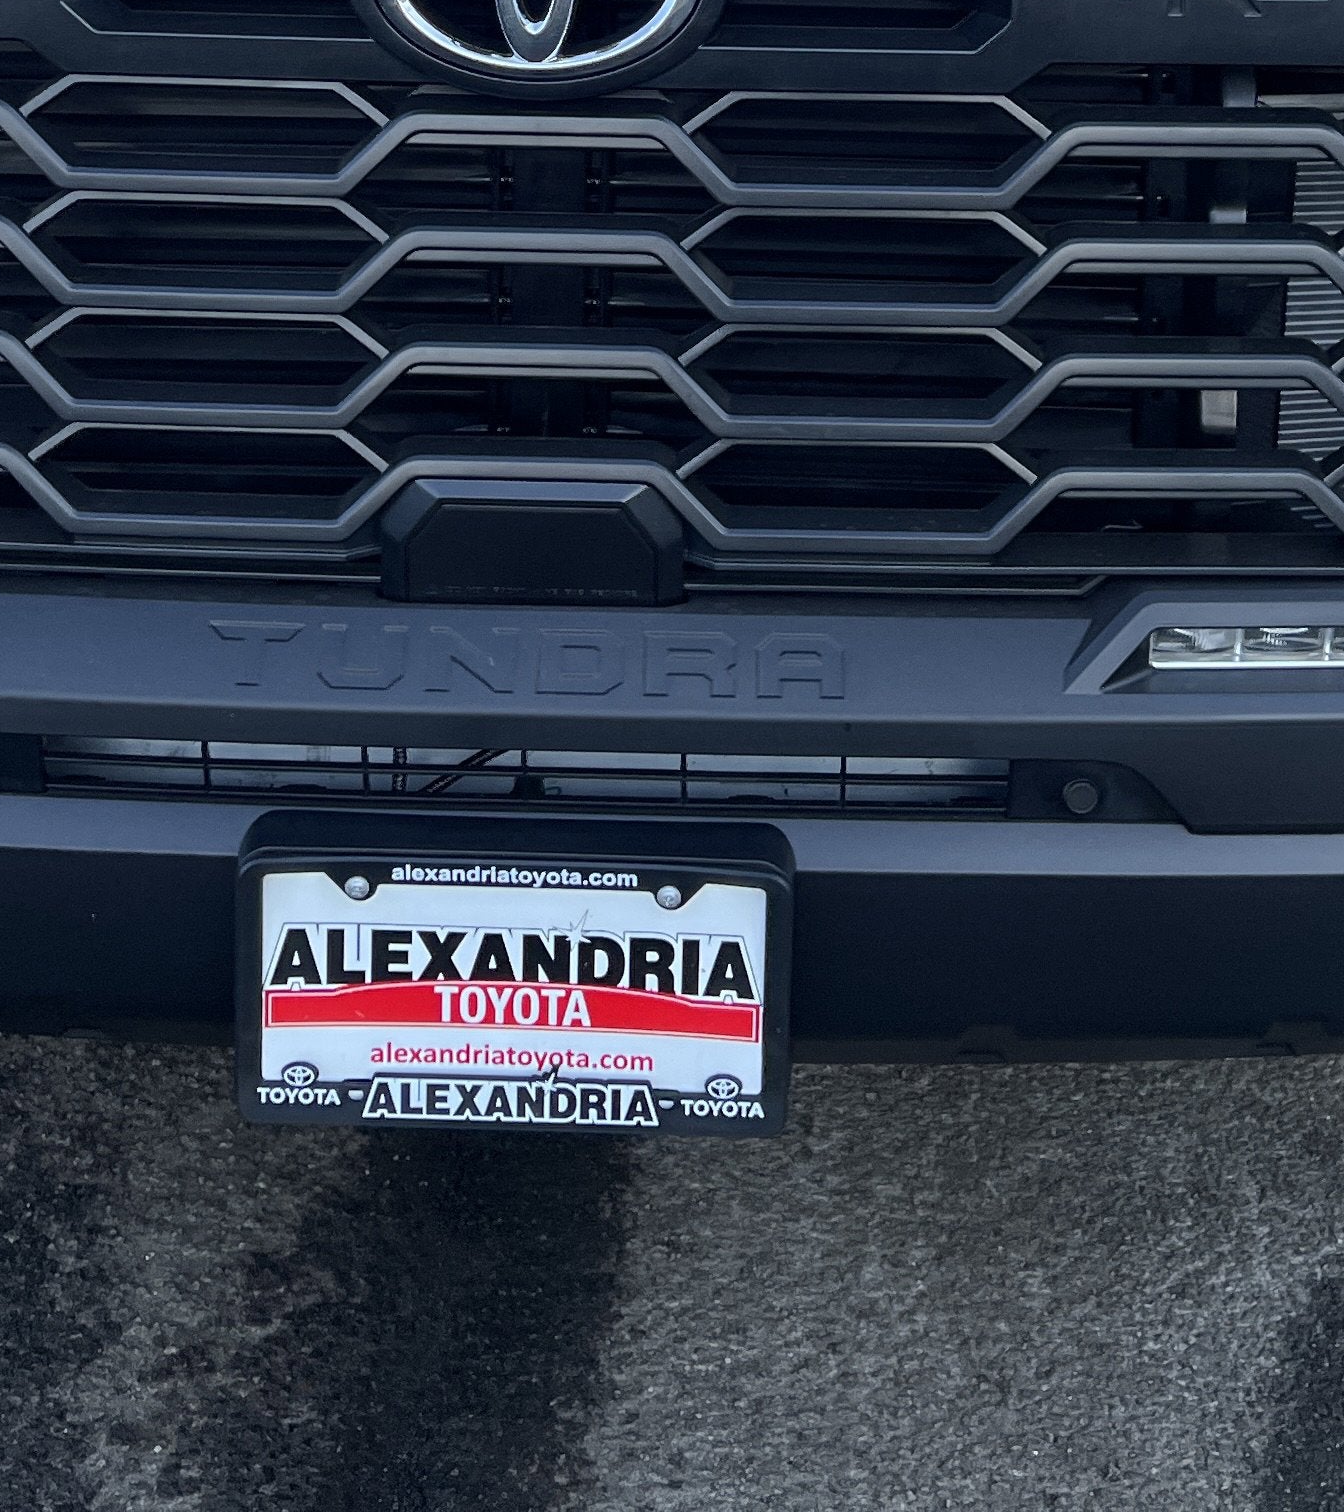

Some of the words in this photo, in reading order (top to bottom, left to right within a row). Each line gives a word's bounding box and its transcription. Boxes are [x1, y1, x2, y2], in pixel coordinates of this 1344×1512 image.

[209, 619, 846, 700] TUNDRA
[391, 863, 638, 888] alexandriatoyota.com
[268, 927, 757, 1001] ALEXANDRIA
[434, 985, 592, 1027] TOYOTA
[370, 1042, 654, 1072] alexandriatoyota.com
[256, 1086, 341, 1106] TOYOTA
[362, 1076, 659, 1127] ALEXANDRIA
[680, 1099, 765, 1119] TOYOTA
